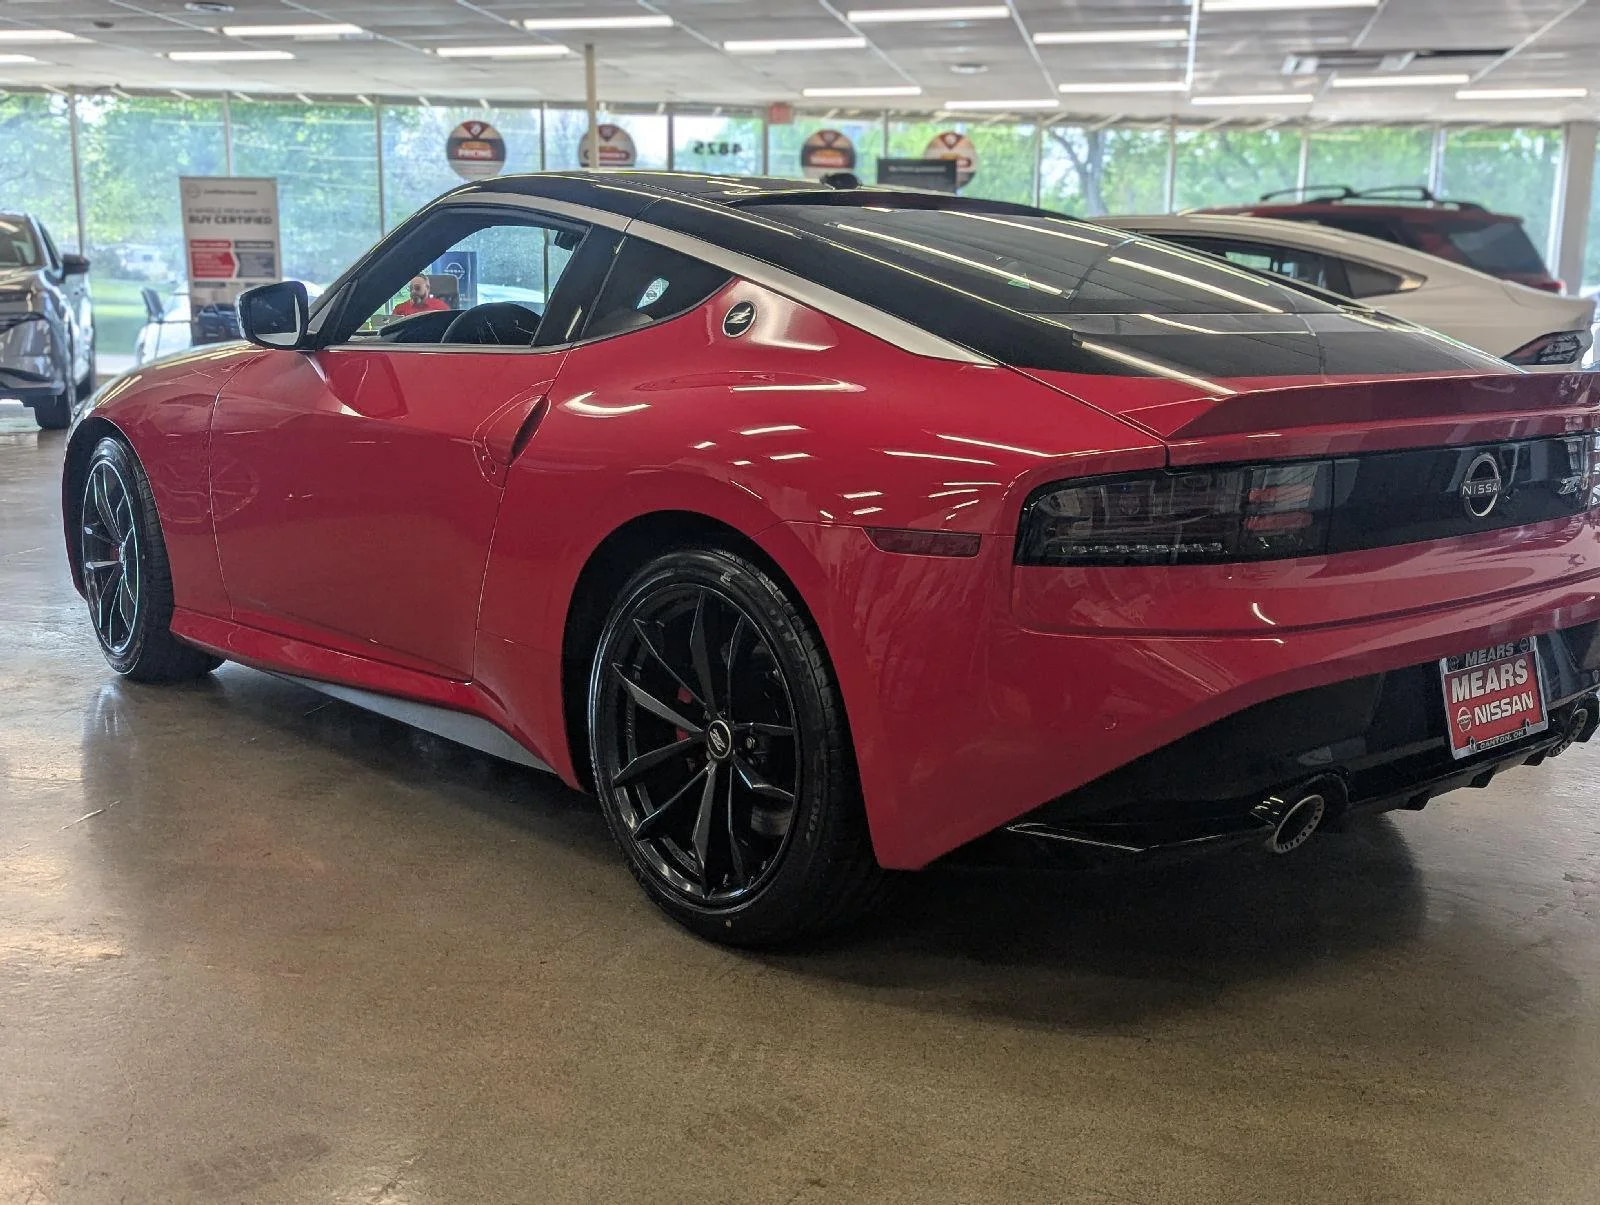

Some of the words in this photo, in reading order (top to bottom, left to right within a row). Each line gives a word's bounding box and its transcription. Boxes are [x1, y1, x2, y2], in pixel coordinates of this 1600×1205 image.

[188, 214, 212, 225] BUY
[214, 214, 273, 225] CERTIFIED
[1465, 642, 1514, 667] MEARS
[1452, 659, 1528, 703] MEARS
[1474, 690, 1534, 726] NISSAN
